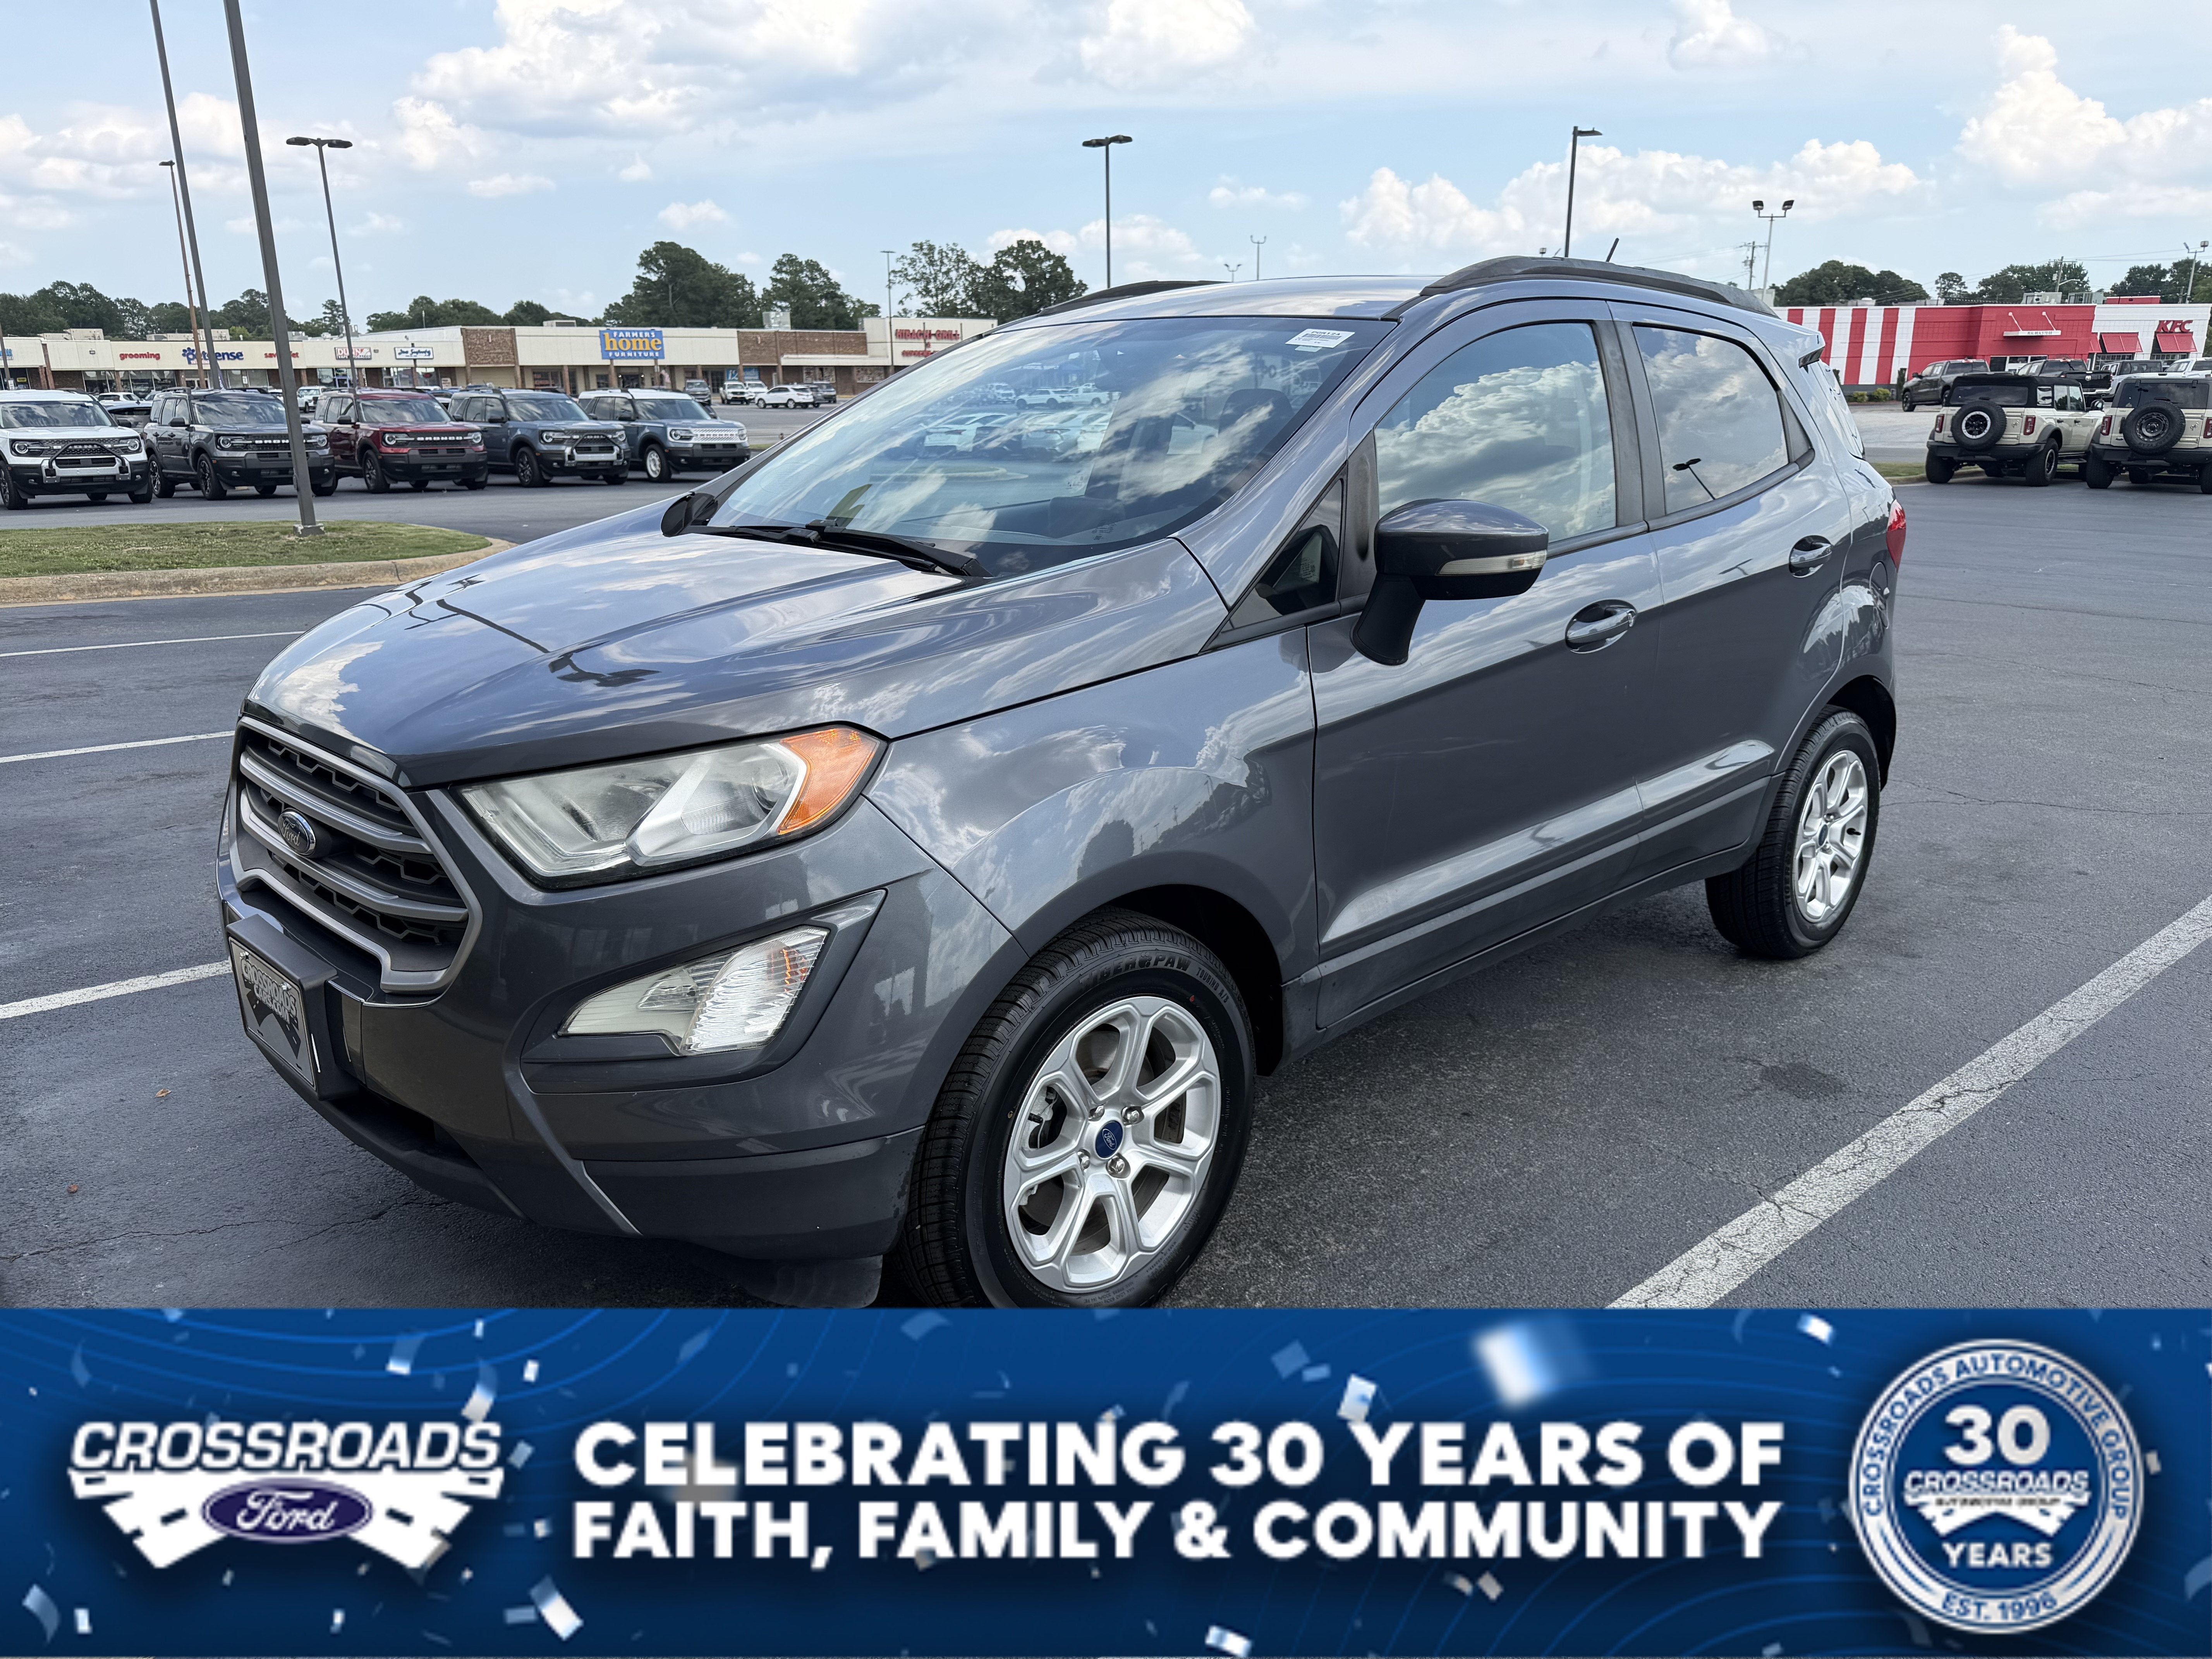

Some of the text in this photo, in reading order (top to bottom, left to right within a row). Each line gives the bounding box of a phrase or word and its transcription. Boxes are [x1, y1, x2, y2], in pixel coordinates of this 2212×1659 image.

[2156, 320, 2193, 332] KFC
[603, 333, 662, 351] home
[119, 352, 160, 361] grooming
[186, 350, 244, 364] ptense
[283, 818, 301, 846] Ford
[1079, 954, 1191, 991] TIGER PAW
[1196, 967, 1219, 991] TOURING
[241, 958, 297, 1017] CROSSROADS
[254, 984, 290, 1024] CARS.COM
[1104, 1132, 1115, 1147] Ford
